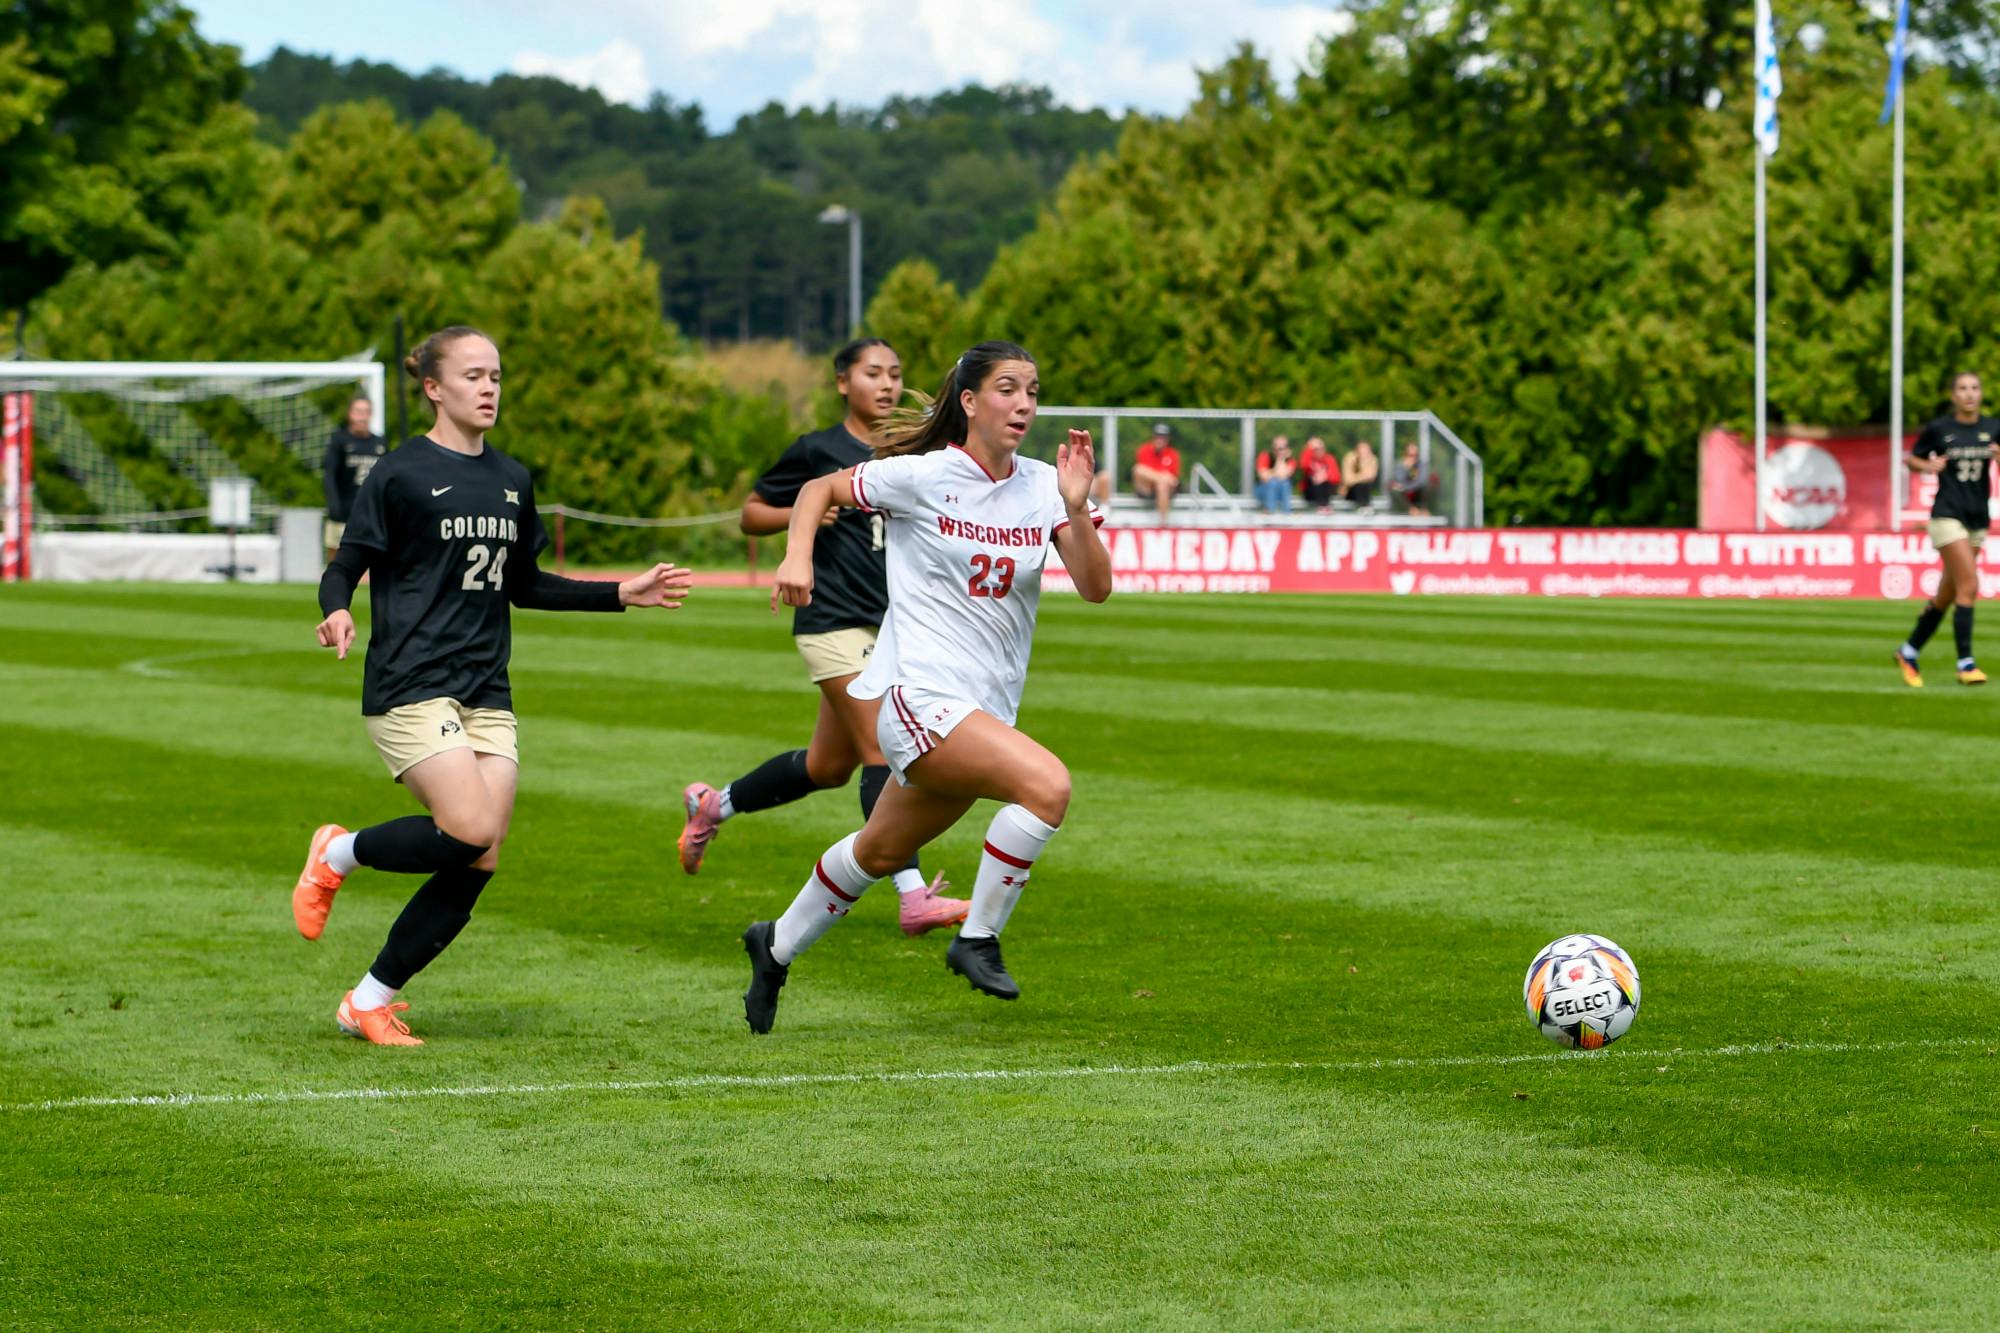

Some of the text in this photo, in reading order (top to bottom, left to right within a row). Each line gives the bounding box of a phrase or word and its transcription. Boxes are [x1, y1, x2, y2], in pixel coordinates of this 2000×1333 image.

[440, 516, 518, 542] COLORAD
[937, 515, 1043, 547] WISCONSIN
[1297, 532, 1379, 572] APP
[1387, 533, 1854, 565] FOLLOW THE BADGERS ON TWITTER
[1865, 535, 1941, 564] FOLLO
[461, 544, 508, 591] 24
[968, 553, 1015, 599] 23
[1554, 990, 1612, 1017] SELECT
